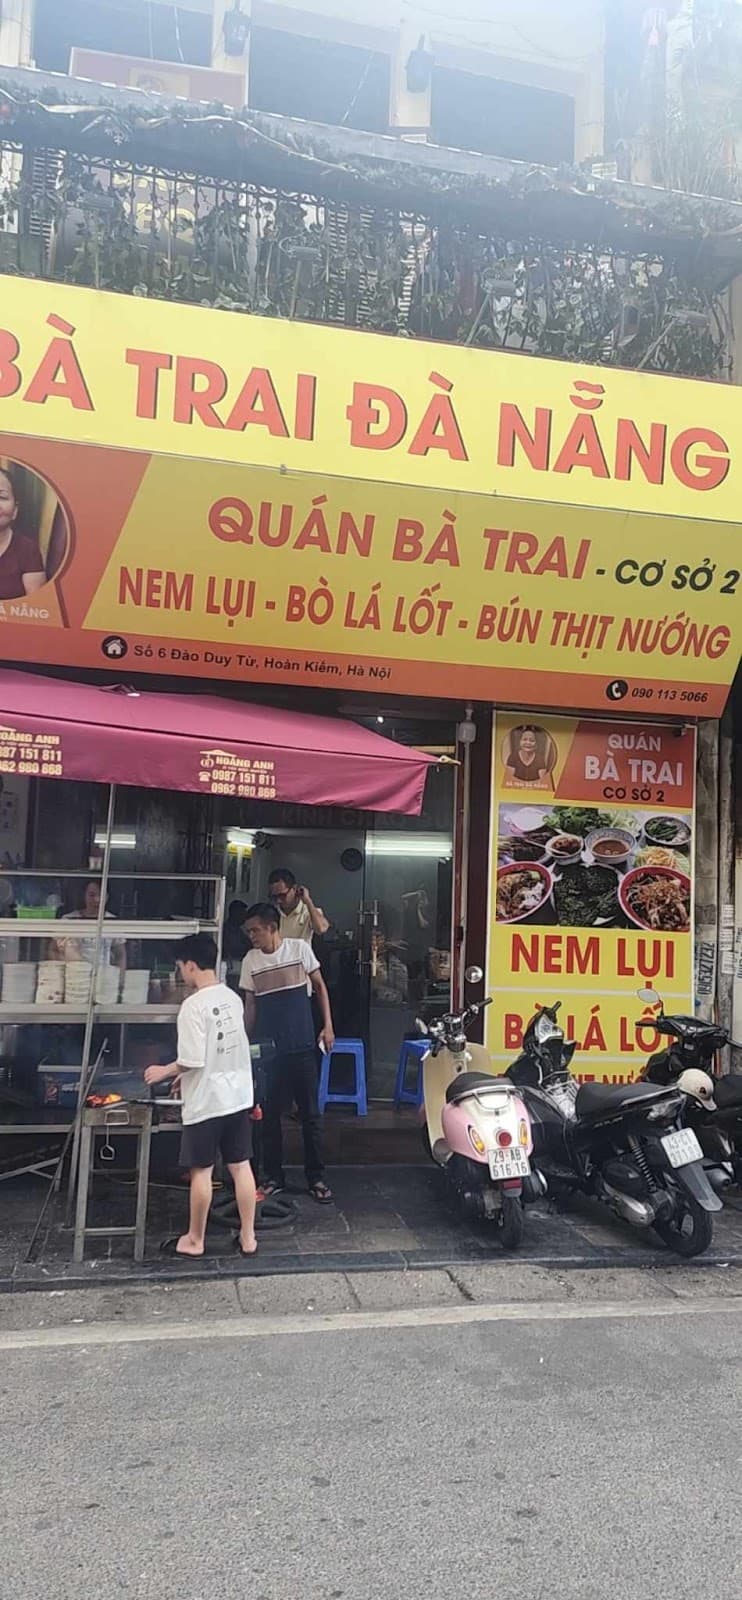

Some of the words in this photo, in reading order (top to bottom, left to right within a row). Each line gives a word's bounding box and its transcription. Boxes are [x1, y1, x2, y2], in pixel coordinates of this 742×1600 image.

[0, 313, 95, 411] BÀ
[126, 349, 316, 441] TRAI
[346, 371, 469, 462] ĐÀ
[497, 380, 730, 491] NẴNG
[208, 494, 375, 557] QUÁN
[392, 509, 460, 567] BÀ
[483, 528, 591, 579] TRAI
[615, 559, 667, 587] CƠ
[671, 558, 717, 592] SỞ
[720, 570, 740, 594] 2
[118, 566, 194, 611] NEM
[205, 576, 256, 627] LỤI
[286, 576, 334, 625] BÒ
[344, 582, 382, 630] LÁ
[392, 582, 453, 636] LỐT
[476, 596, 542, 644] BÚN
[550, 611, 615, 659] THỊT
[616, 610, 731, 660] NƯỚNG
[158, 647, 167, 659] 6
[204, 651, 232, 667] Duy
[264, 657, 300, 671] Hoàn
[304, 660, 342, 676] Kiếm,
[347, 664, 364, 676] Hà
[369, 666, 391, 681] Nội
[631, 687, 653, 699] 090
[657, 689, 677, 700] 113
[680, 691, 708, 702] 5066
[35, 734, 60, 745] ANH
[608, 732, 661, 752] QUÁN
[20, 747, 39, 760] 151
[42, 750, 62, 762] 811
[253, 760, 275, 771] ANH
[585, 750, 620, 782] BÀ
[628, 758, 683, 786] TRAI
[212, 769, 237, 782] 0987
[239, 772, 256, 785] 151
[211, 782, 236, 795] 0962
[656, 790, 665, 802] 2
[511, 933, 600, 975] NEM
[617, 938, 674, 989] LỤI
[567, 1004, 606, 1051] LÁ
[620, 1002, 676, 1052] LỐ
